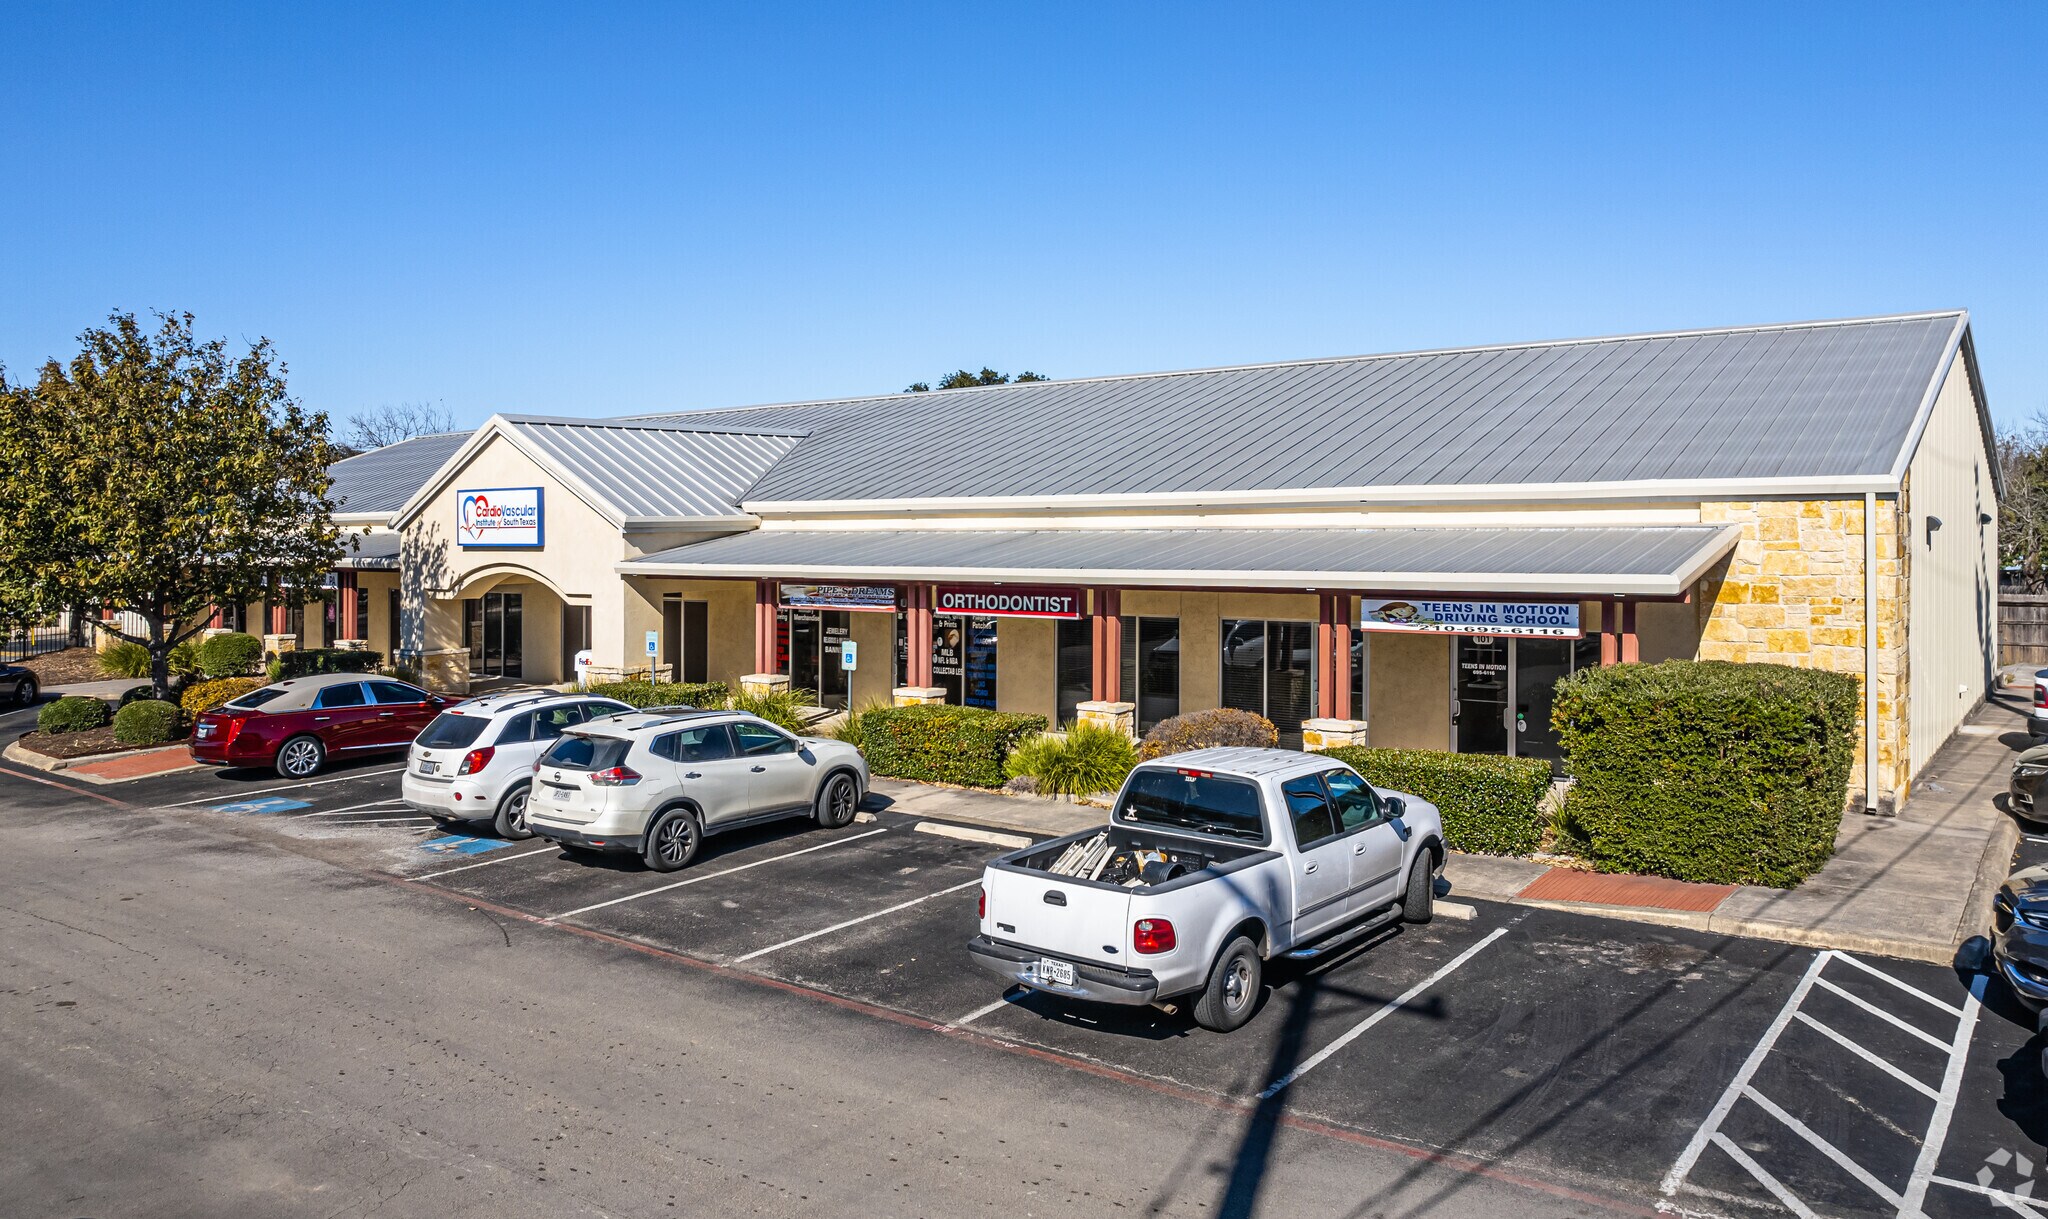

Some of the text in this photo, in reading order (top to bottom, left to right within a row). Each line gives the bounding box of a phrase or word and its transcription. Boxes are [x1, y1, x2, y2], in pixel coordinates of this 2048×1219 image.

[476, 504, 536, 517] CardioVascular
[503, 518, 519, 526] South
[520, 518, 536, 526] Texas
[851, 587, 895, 596] DREAMS
[942, 593, 1072, 612] ORTHODONTIST
[1422, 602, 1570, 615] TEENS IN MOTION
[944, 620, 957, 628] Prints
[1434, 613, 1570, 625] DRIVING SCHOOL
[1418, 625, 1564, 635] 210-695-6116
